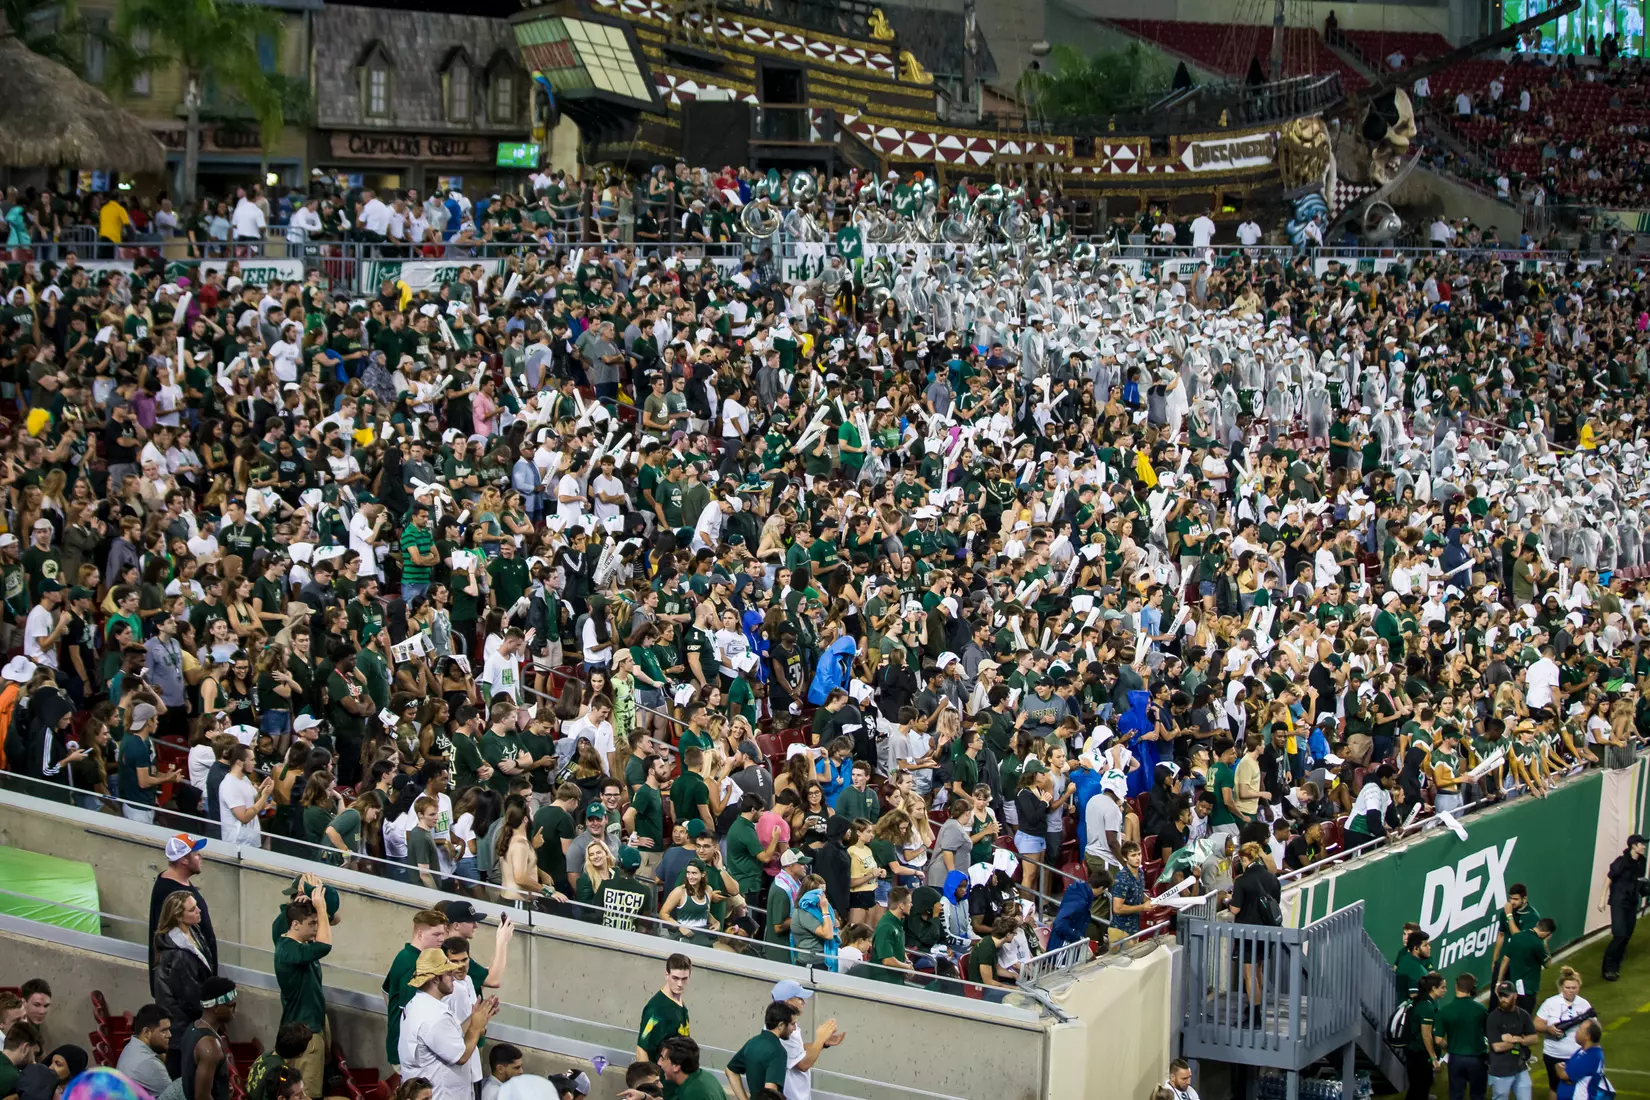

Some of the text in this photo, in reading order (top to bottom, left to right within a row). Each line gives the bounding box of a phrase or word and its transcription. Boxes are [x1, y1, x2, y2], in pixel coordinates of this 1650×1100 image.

[428, 137, 471, 156] GRILL
[693, 631, 699, 640] 1
[1419, 836, 1518, 943] DEX
[605, 890, 643, 908] BITCH
